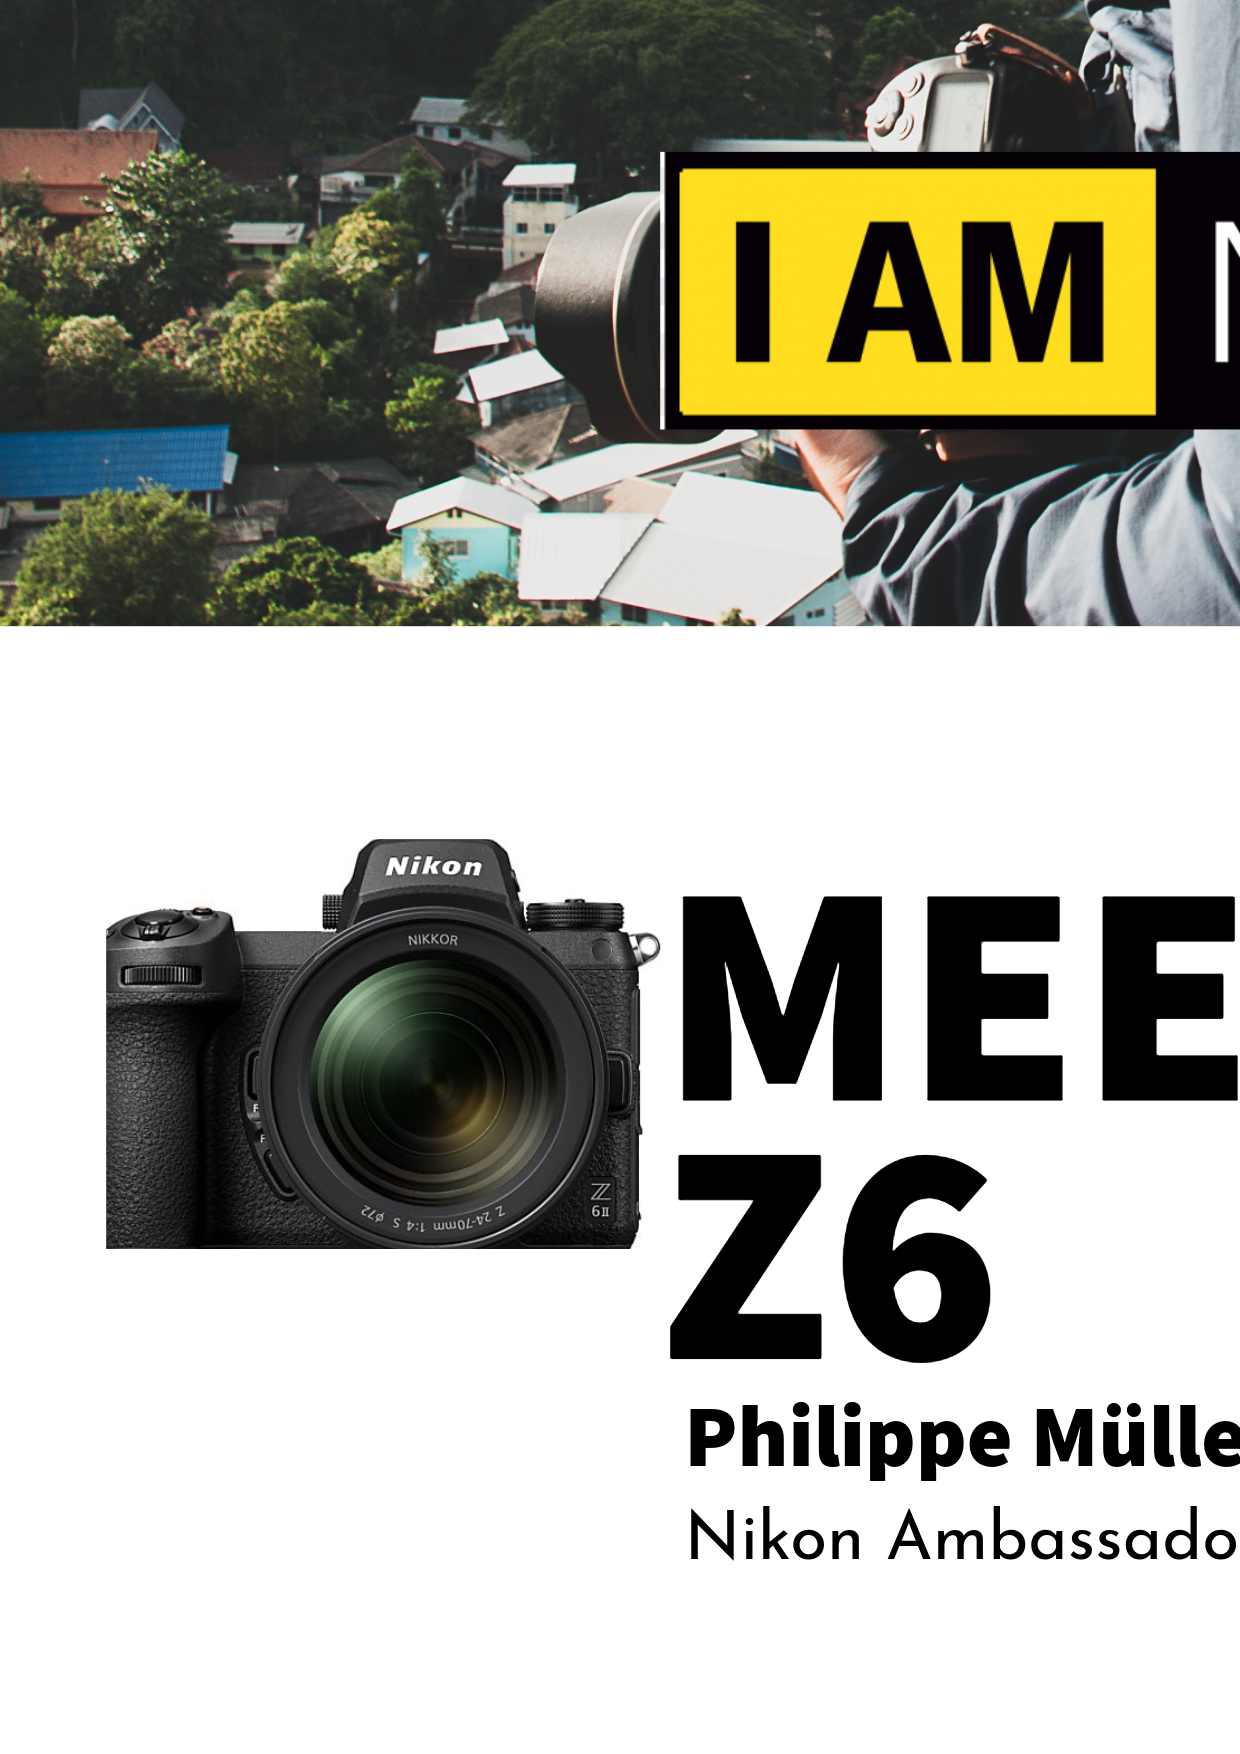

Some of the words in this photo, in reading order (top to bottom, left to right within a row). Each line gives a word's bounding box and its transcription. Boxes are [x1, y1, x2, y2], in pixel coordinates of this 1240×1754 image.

[385, 855, 483, 877] Nikon
[408, 933, 458, 946] NIKKOR
[495, 1205, 506, 1217] Z
[392, 1217, 401, 1228] S
[406, 1220, 425, 1233] 1:4
[433, 1212, 492, 1230] 24-70mm
